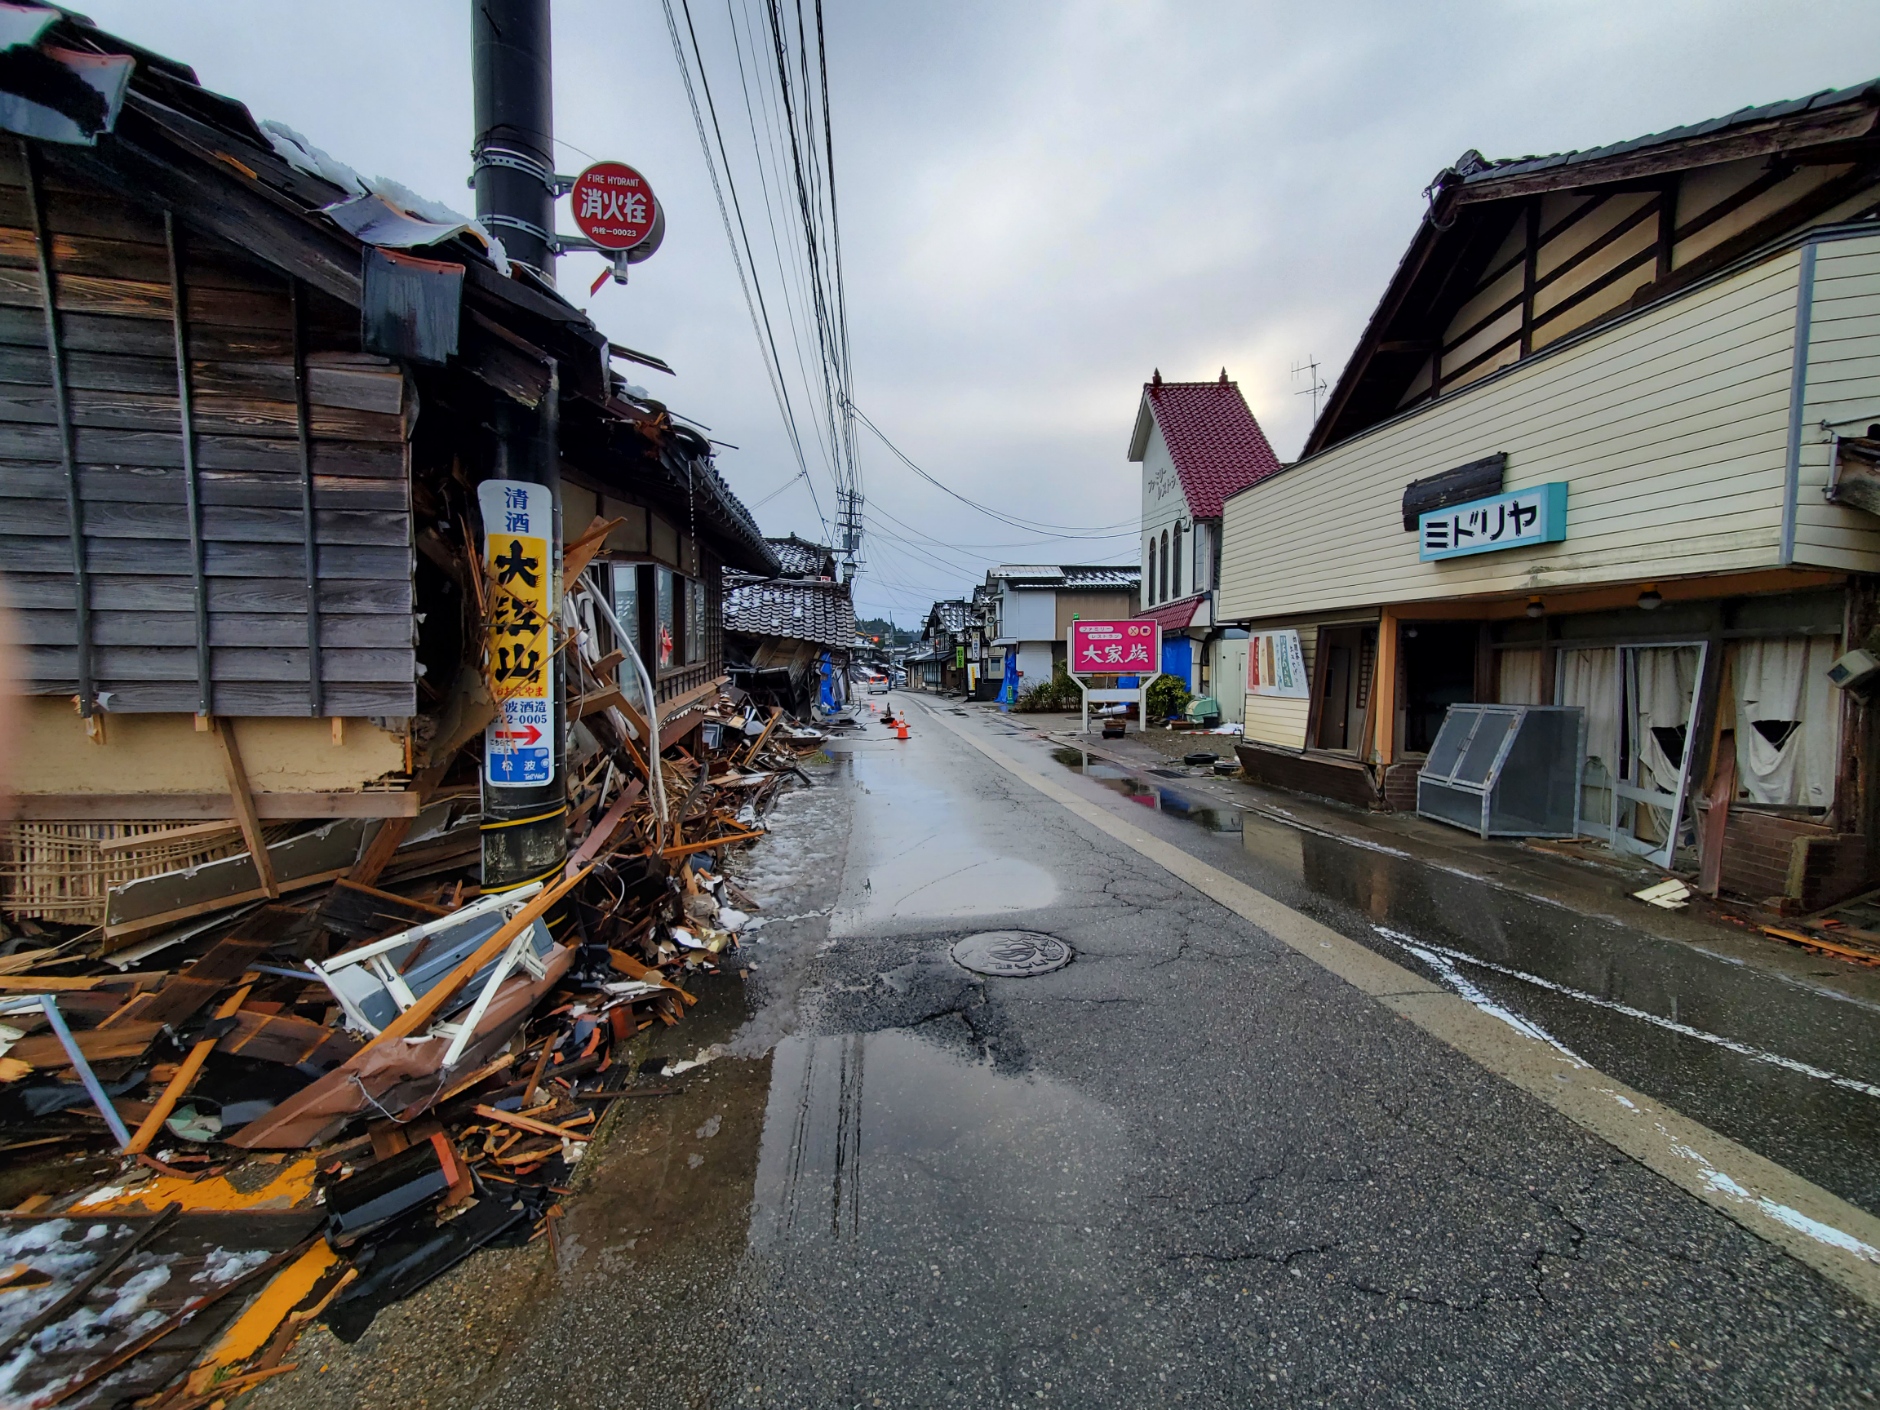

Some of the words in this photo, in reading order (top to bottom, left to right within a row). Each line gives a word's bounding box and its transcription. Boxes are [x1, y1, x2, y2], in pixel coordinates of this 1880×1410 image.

[587, 174, 605, 184] FIRE
[607, 176, 640, 187] HYDRANT
[580, 188, 647, 223] 消火栓
[503, 486, 530, 534] 清酒
[1424, 500, 1537, 549] ミドリヤ
[494, 539, 543, 684] 大江山
[1081, 643, 1149, 664] 大家族
[494, 701, 547, 713] 波酒造
[502, 760, 536, 771] 松波
